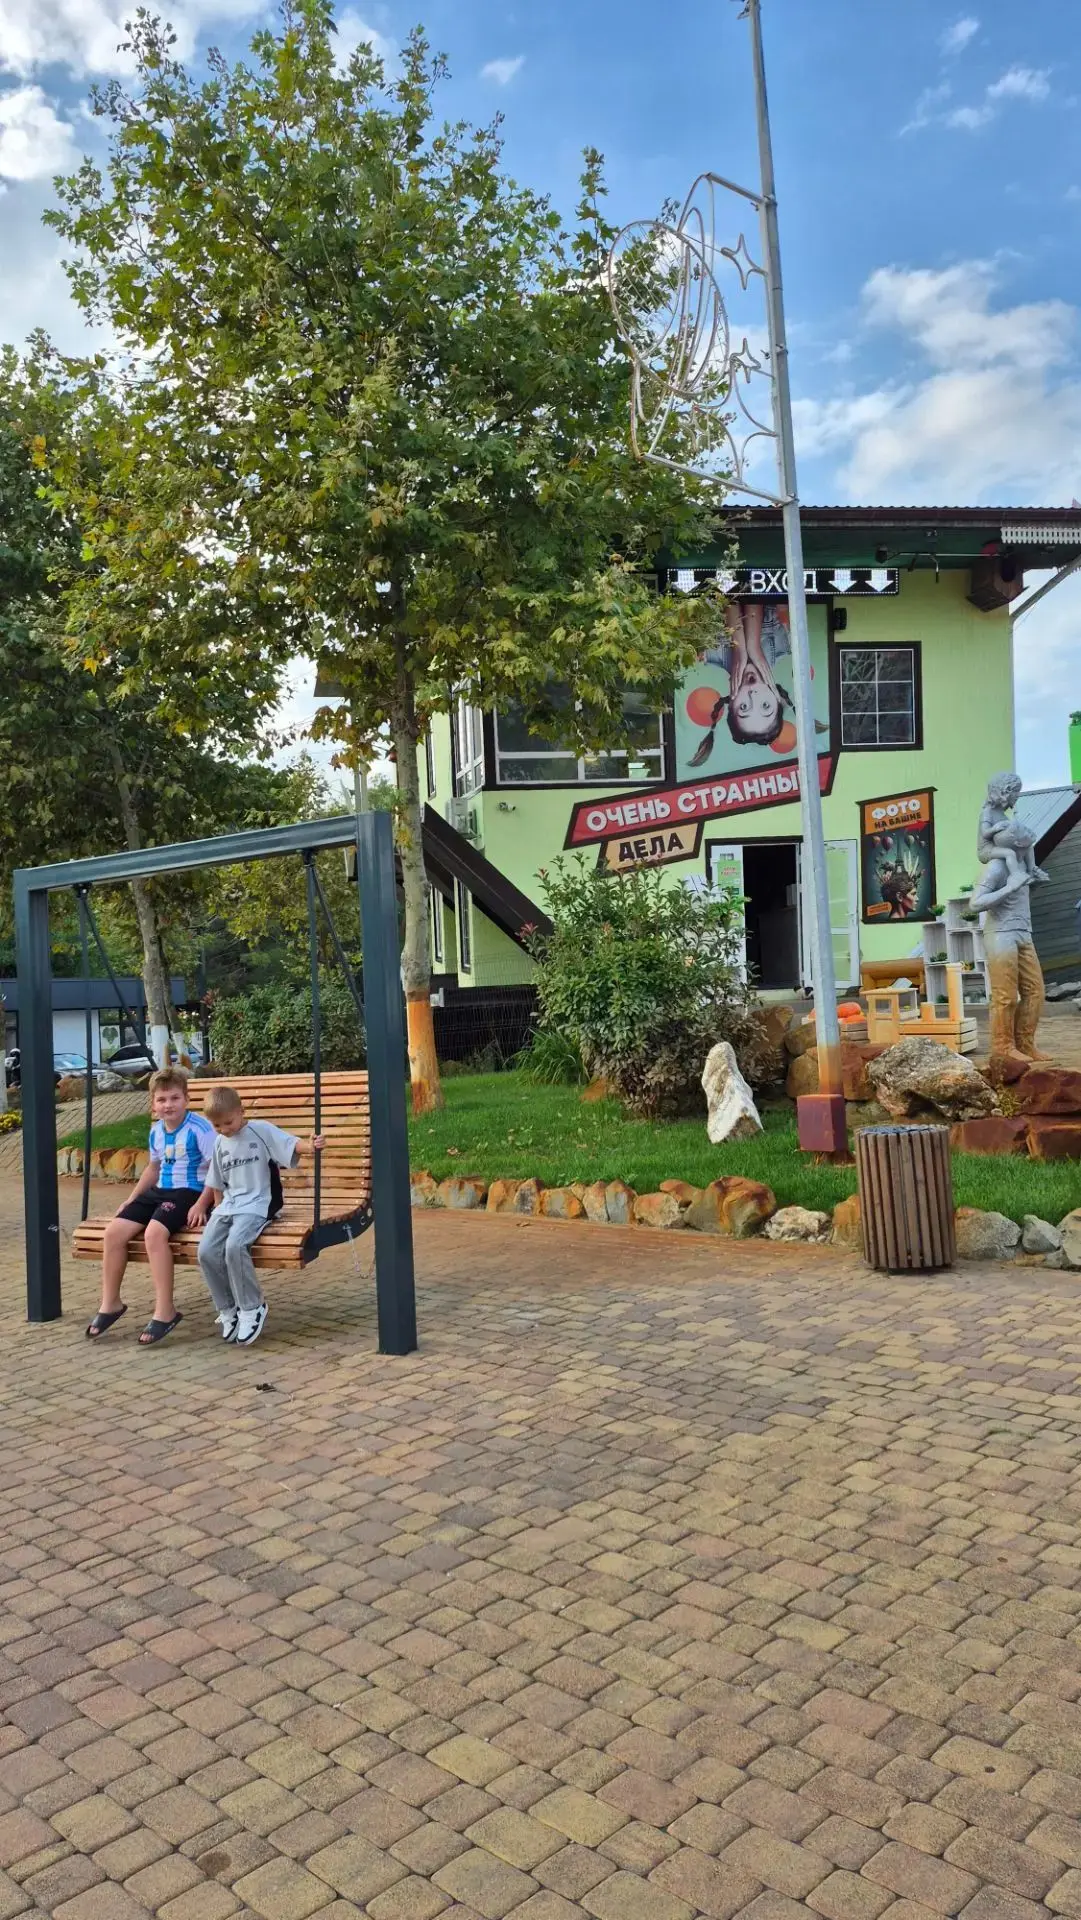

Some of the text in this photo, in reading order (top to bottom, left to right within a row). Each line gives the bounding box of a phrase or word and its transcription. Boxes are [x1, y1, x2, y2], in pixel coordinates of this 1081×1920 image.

[751, 570, 818, 592] ВХД
[586, 769, 802, 832] ОЧЕНЬ СТРАННЫ
[872, 799, 920, 819] ФОТО
[874, 821, 887, 829] НА
[618, 832, 684, 862] ДЕЛА
